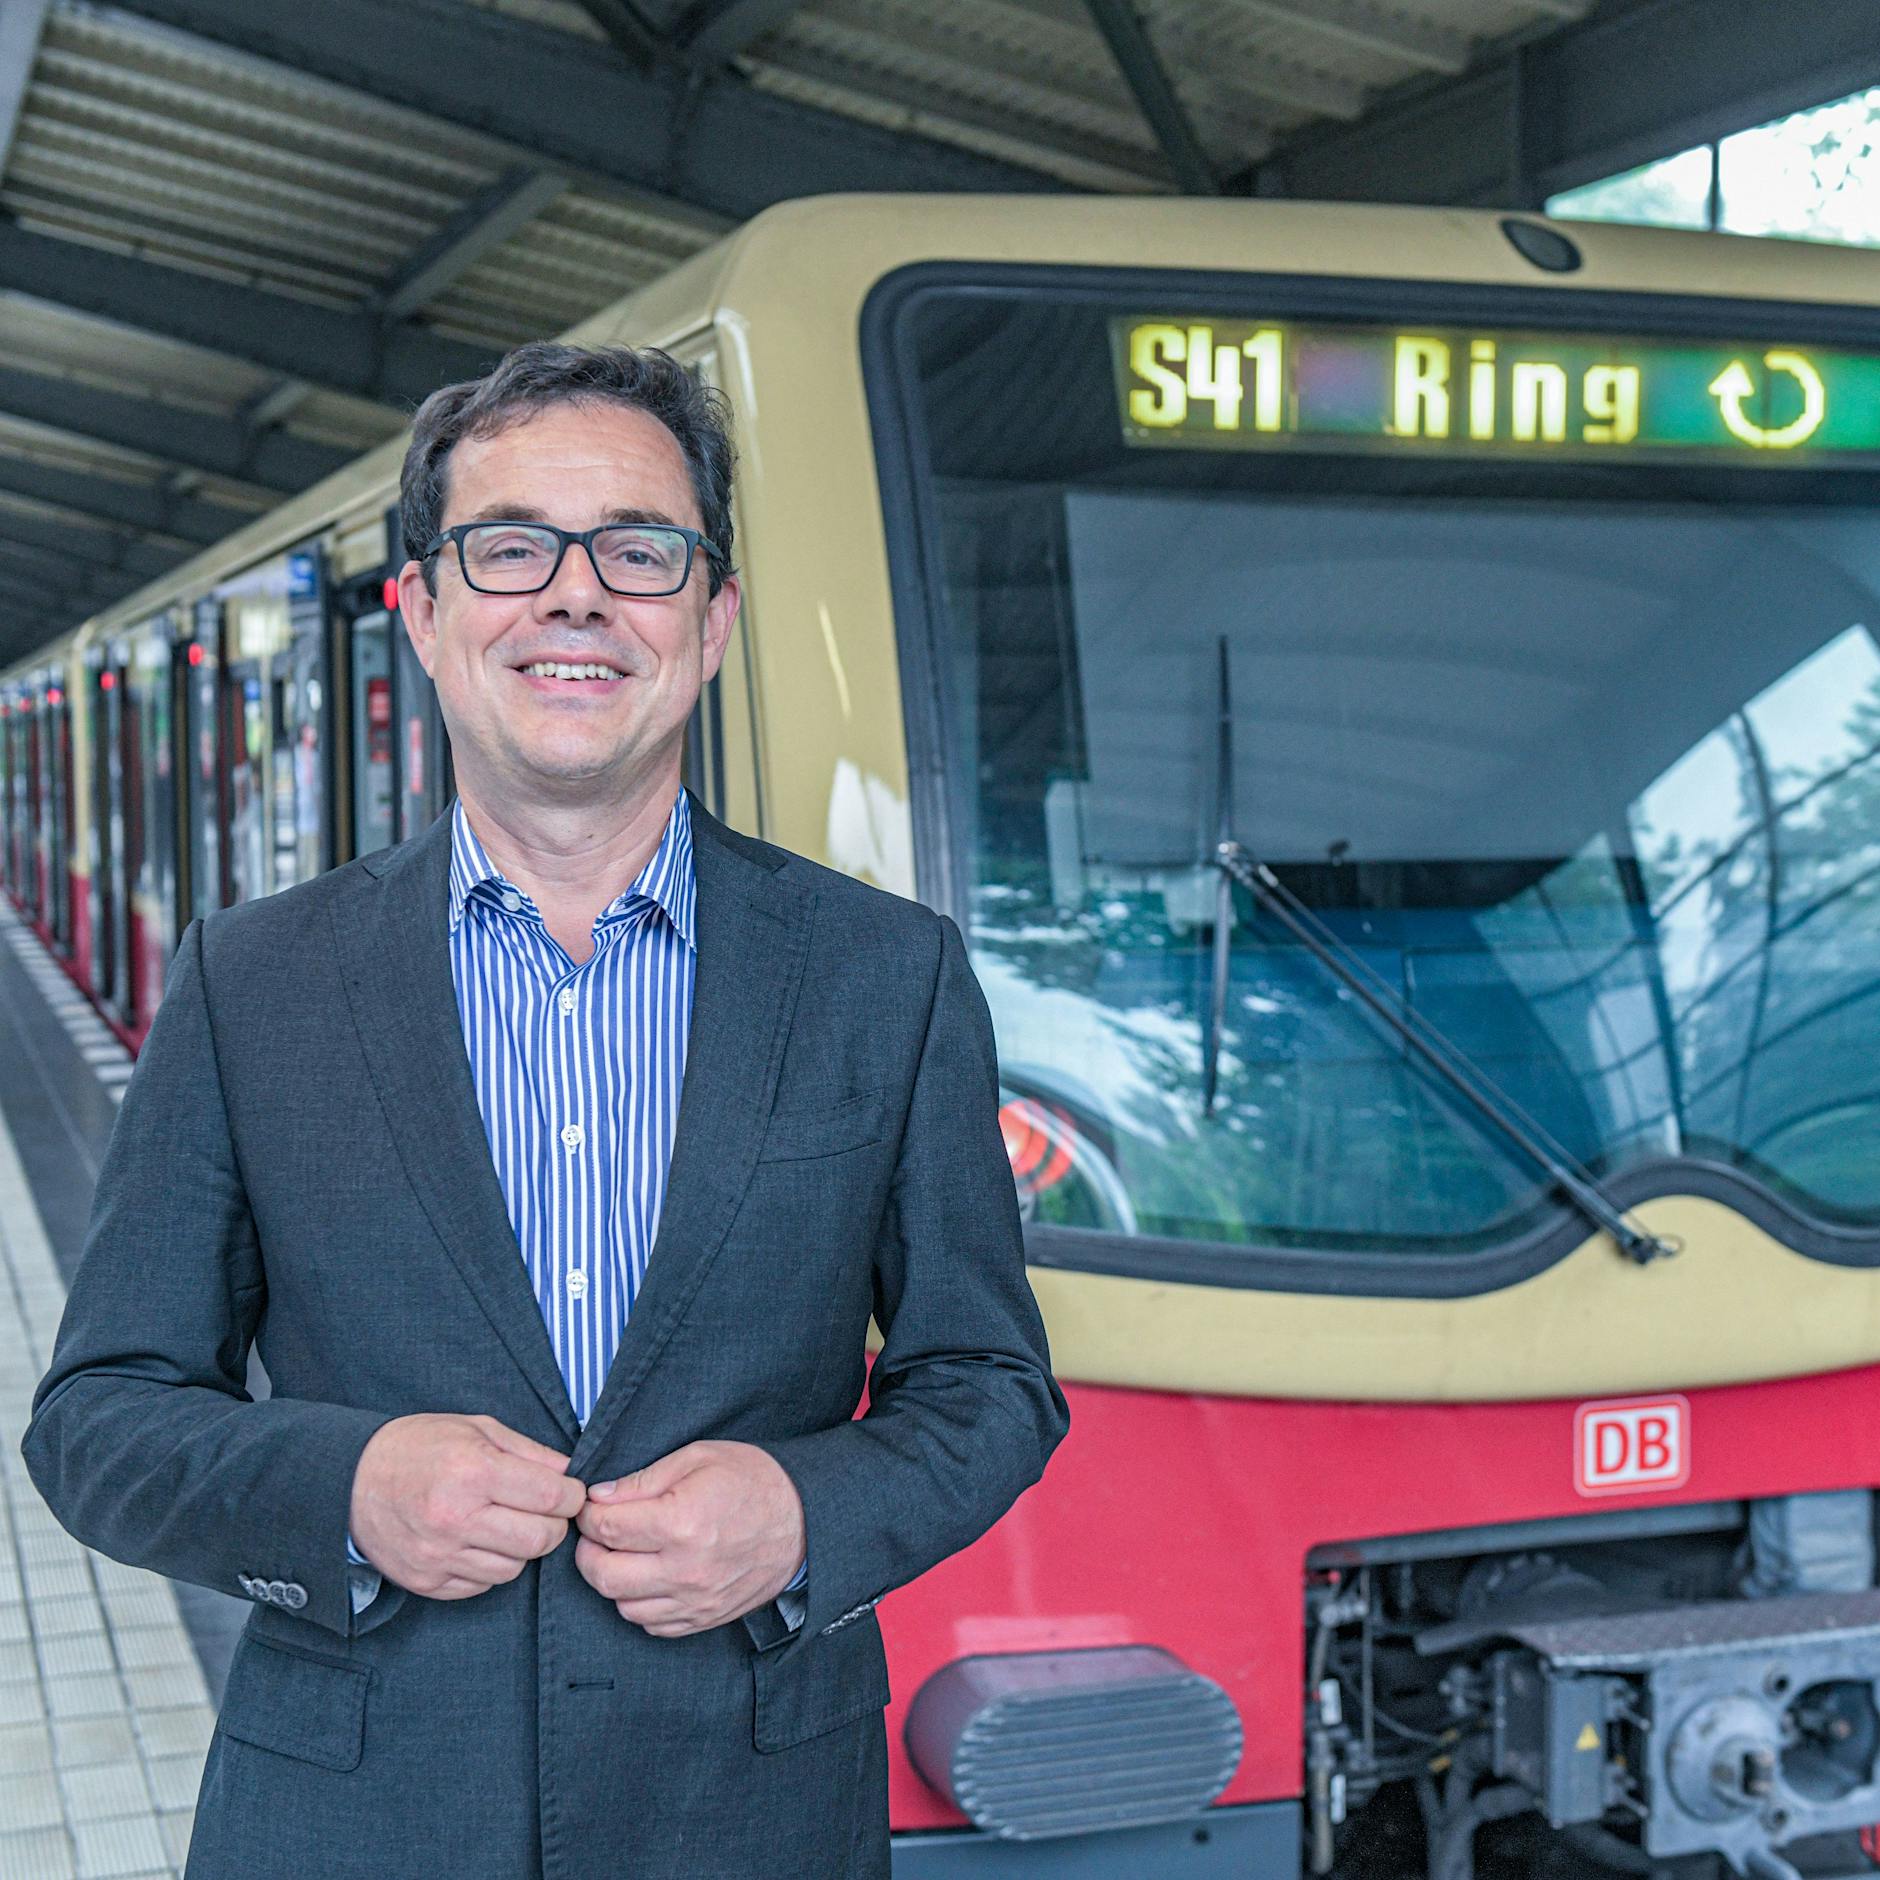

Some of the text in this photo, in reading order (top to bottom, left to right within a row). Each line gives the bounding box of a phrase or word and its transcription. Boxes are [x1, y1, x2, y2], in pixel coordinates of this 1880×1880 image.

[1130, 324, 1639, 443] S41 Ring
[1595, 1418, 1671, 1475] DB
